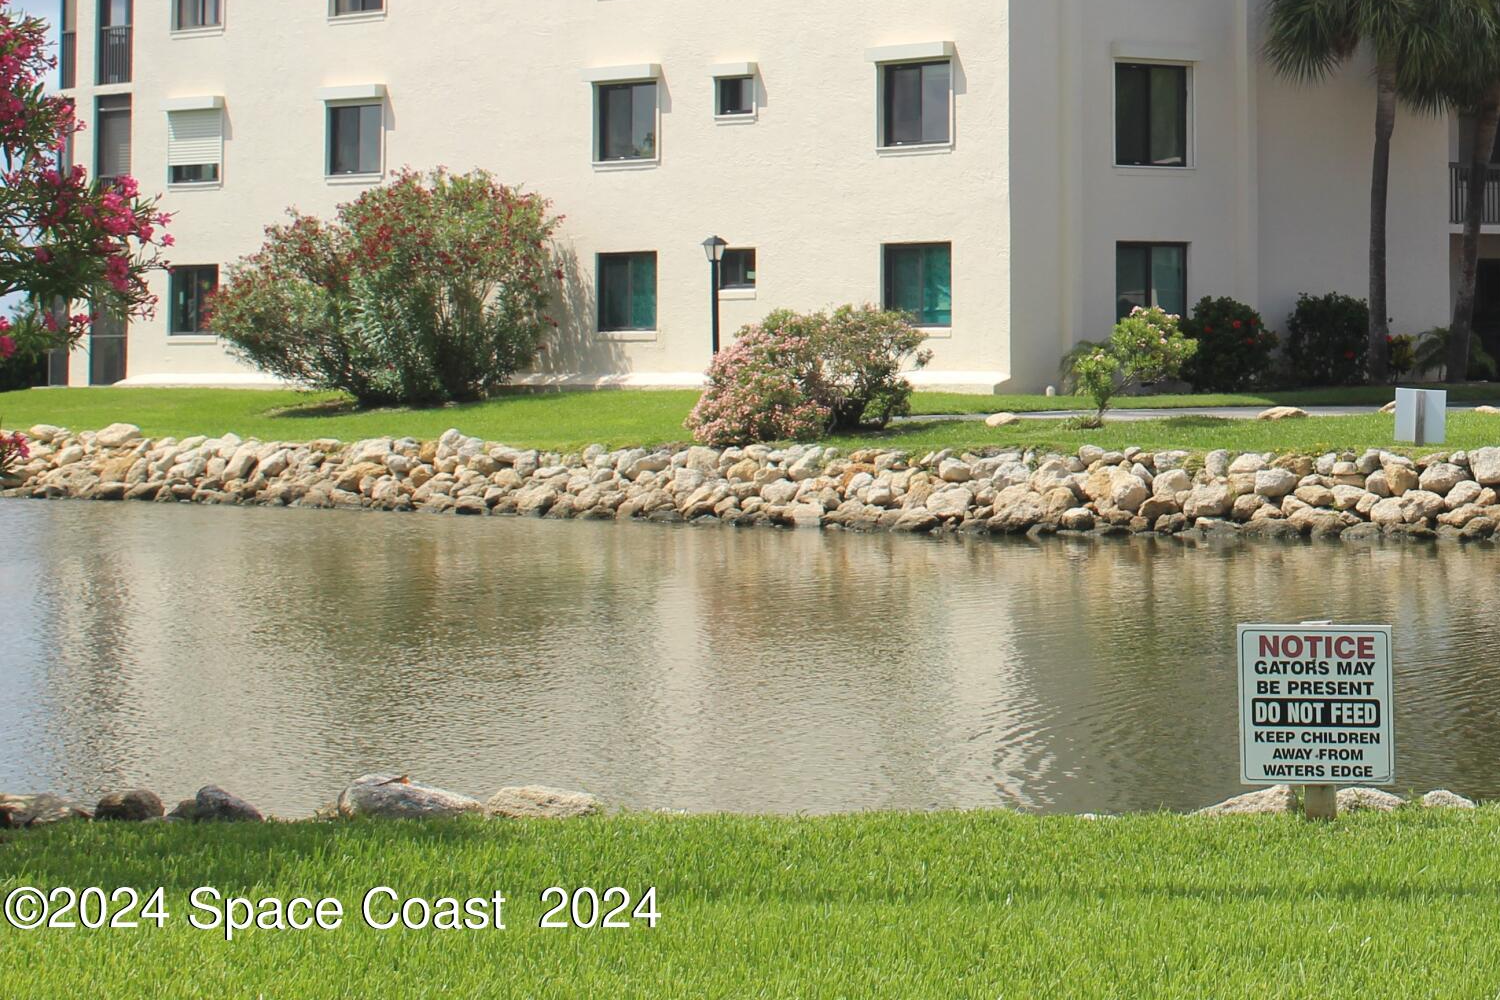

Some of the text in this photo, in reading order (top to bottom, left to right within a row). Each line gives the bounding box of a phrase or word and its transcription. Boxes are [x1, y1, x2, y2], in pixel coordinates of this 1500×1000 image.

[1259, 635, 1375, 659] NOTICE
[1254, 661, 1375, 676] GATORS MAY
[1257, 681, 1374, 695] BE PRESENT
[1255, 702, 1377, 725] DO NOT FEED
[1254, 731, 1380, 744] KEEP CHILDREN
[1273, 748, 1363, 761] AWAY FROM
[1263, 765, 1373, 778] WATERS EDGE
